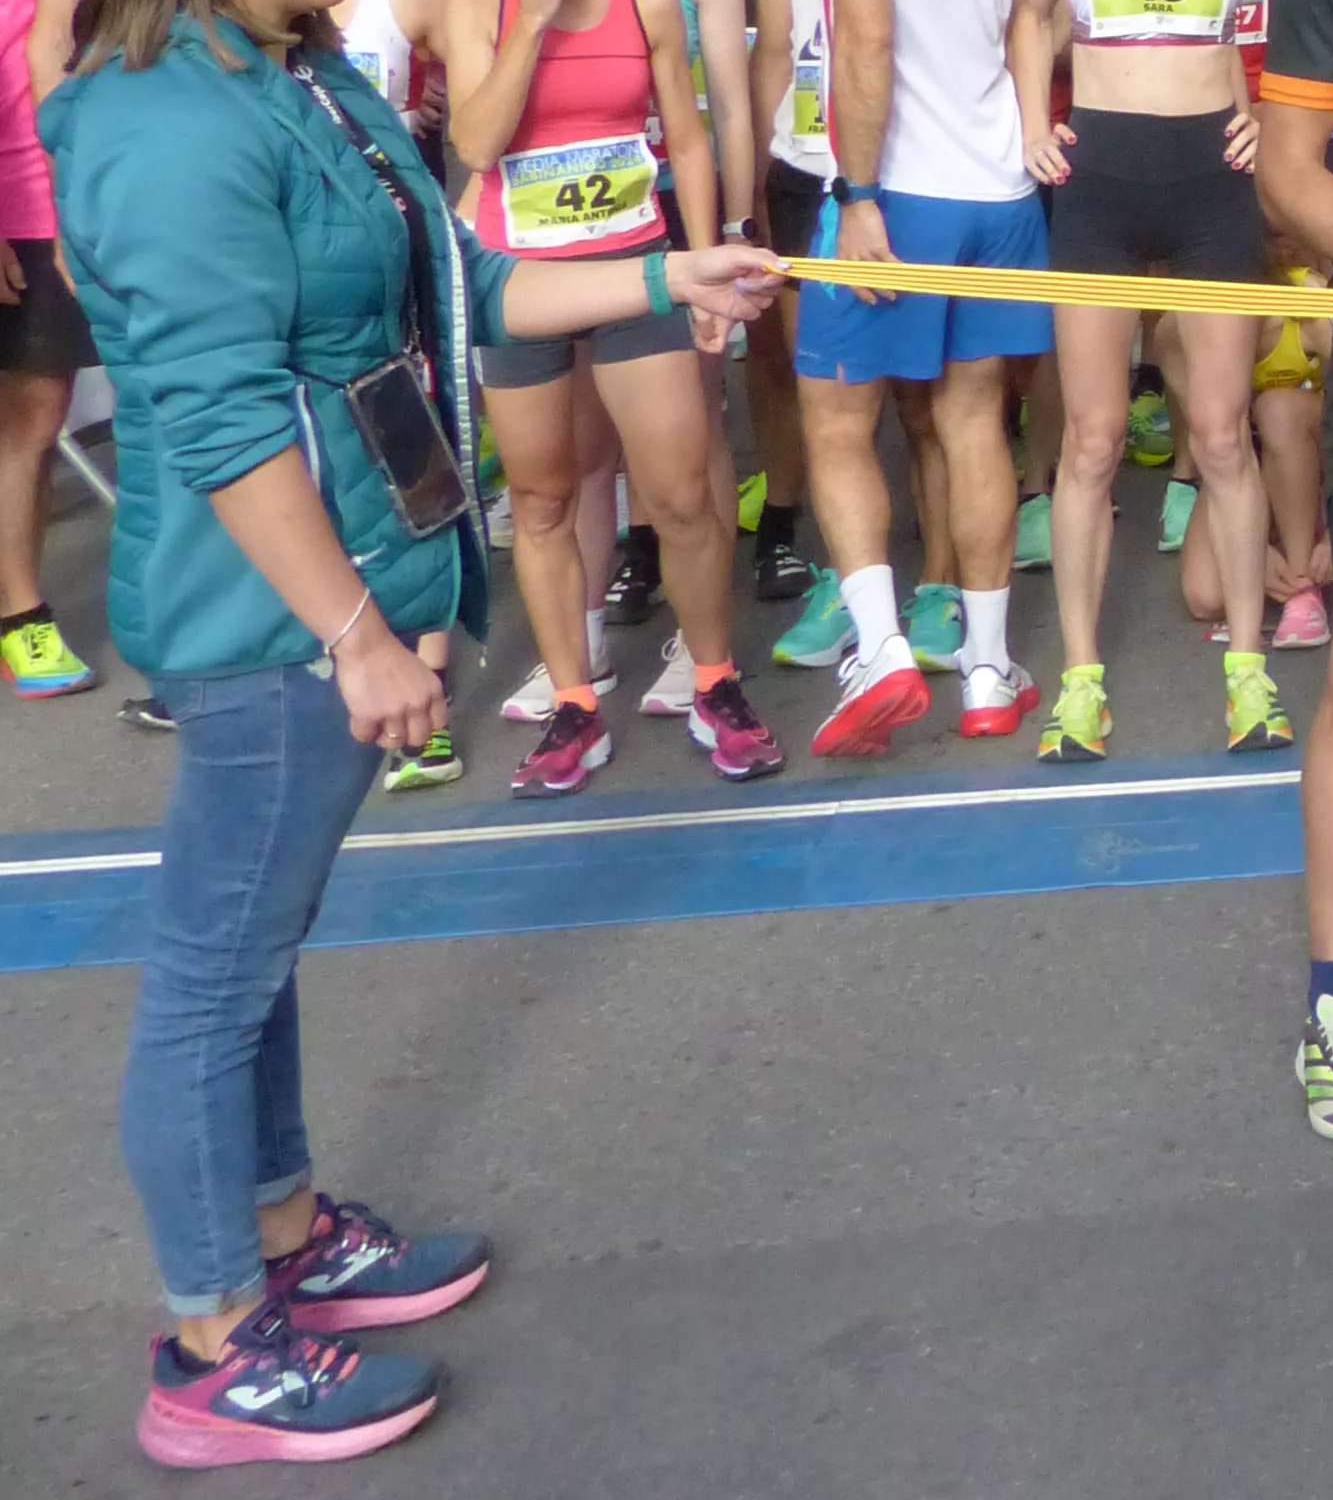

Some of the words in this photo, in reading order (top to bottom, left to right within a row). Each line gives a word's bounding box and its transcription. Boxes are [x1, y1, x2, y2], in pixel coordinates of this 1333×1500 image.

[1144, 4, 1174, 13] SARA
[508, 154, 560, 175] MEDIA
[566, 140, 641, 164] MARATON
[556, 174, 616, 212] 42
